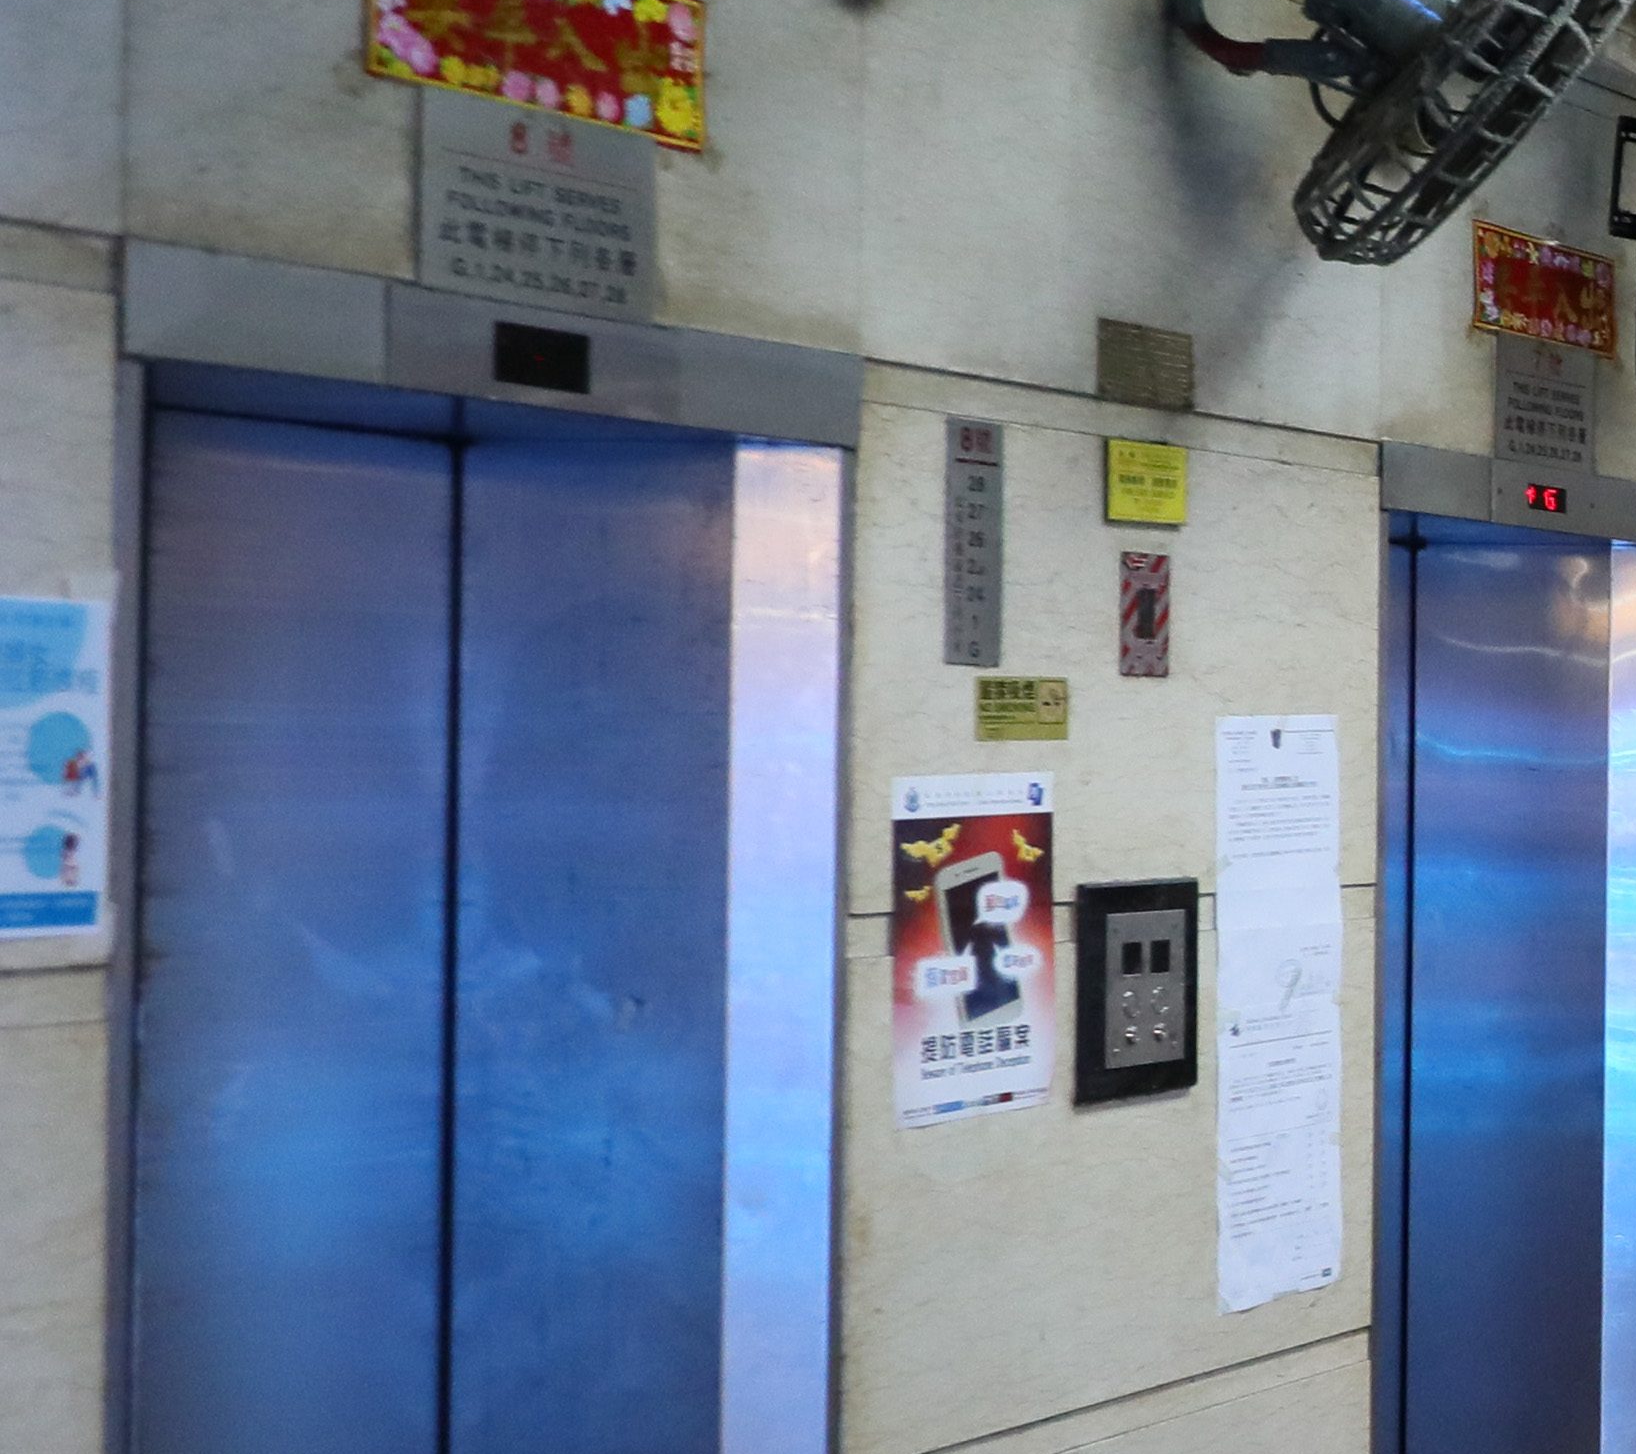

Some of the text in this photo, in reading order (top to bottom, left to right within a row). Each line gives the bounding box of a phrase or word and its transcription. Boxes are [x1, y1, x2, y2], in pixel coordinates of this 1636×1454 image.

[460, 165, 622, 216] THIS LIFT SERVES
[446, 189, 632, 243] FOLLOWING FLOORS
[1507, 397, 1551, 416] FOLLOWING
[921, 1024, 1031, 1064] 提防電話騙案
